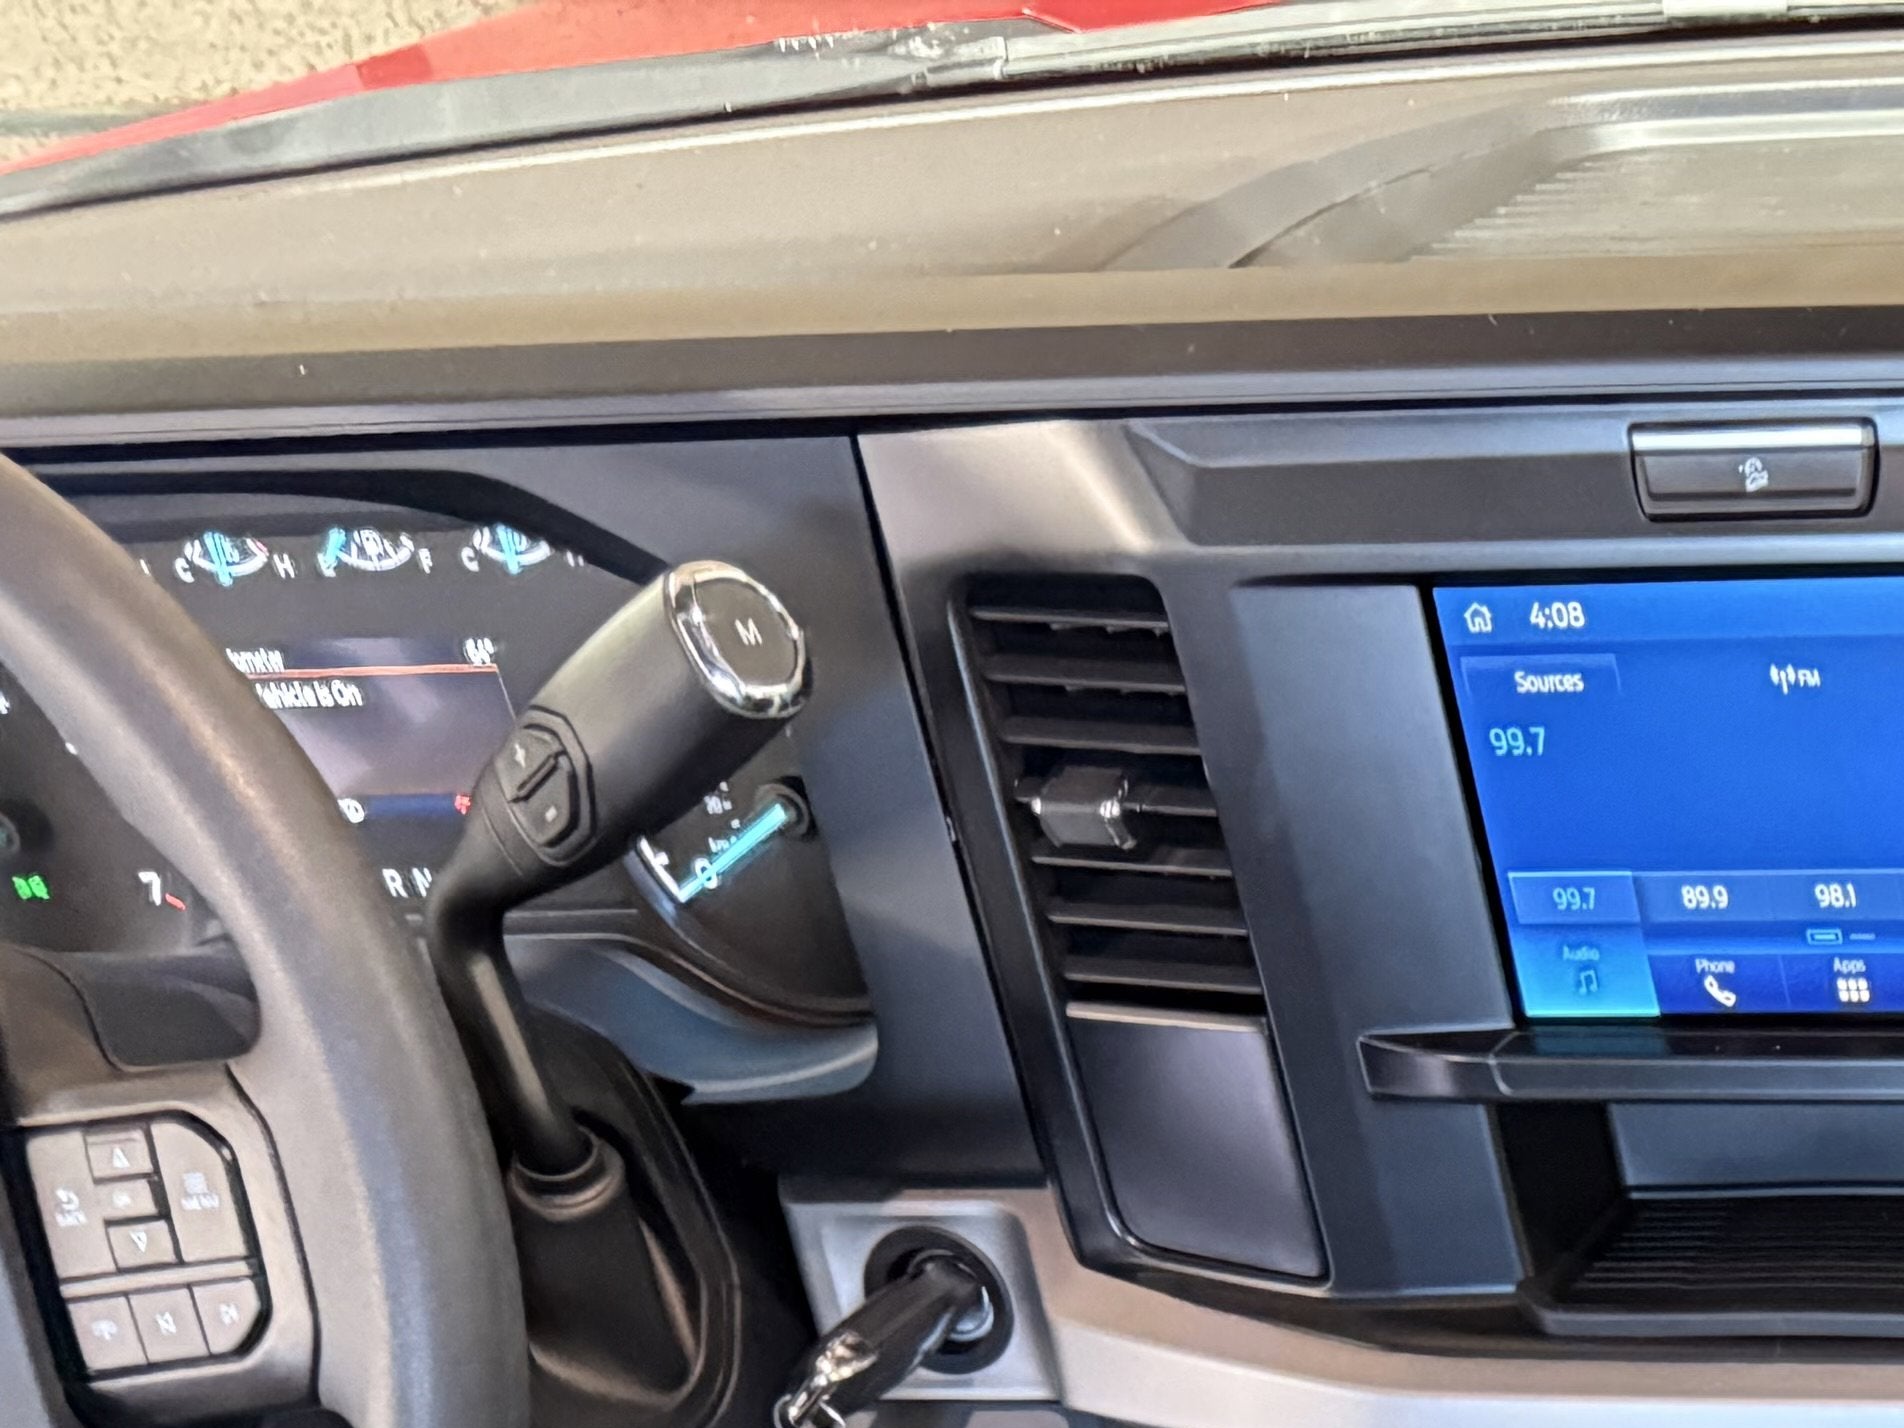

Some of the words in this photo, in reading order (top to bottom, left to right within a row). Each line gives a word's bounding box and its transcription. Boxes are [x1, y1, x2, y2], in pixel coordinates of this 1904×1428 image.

[1528, 600, 1586, 629] 4:08
[735, 617, 763, 646] M
[1513, 670, 1585, 694] Sources
[1799, 668, 1821, 688] FM
[1488, 726, 1546, 757] 99.7
[381, 867, 408, 898] R
[1552, 887, 1596, 911] 99.7
[1681, 884, 1729, 910] 89.9
[1814, 882, 1857, 908] 98.1
[1562, 944, 1600, 961] Audio
[1695, 957, 1736, 974] Phone
[1833, 956, 1867, 974] Apps
